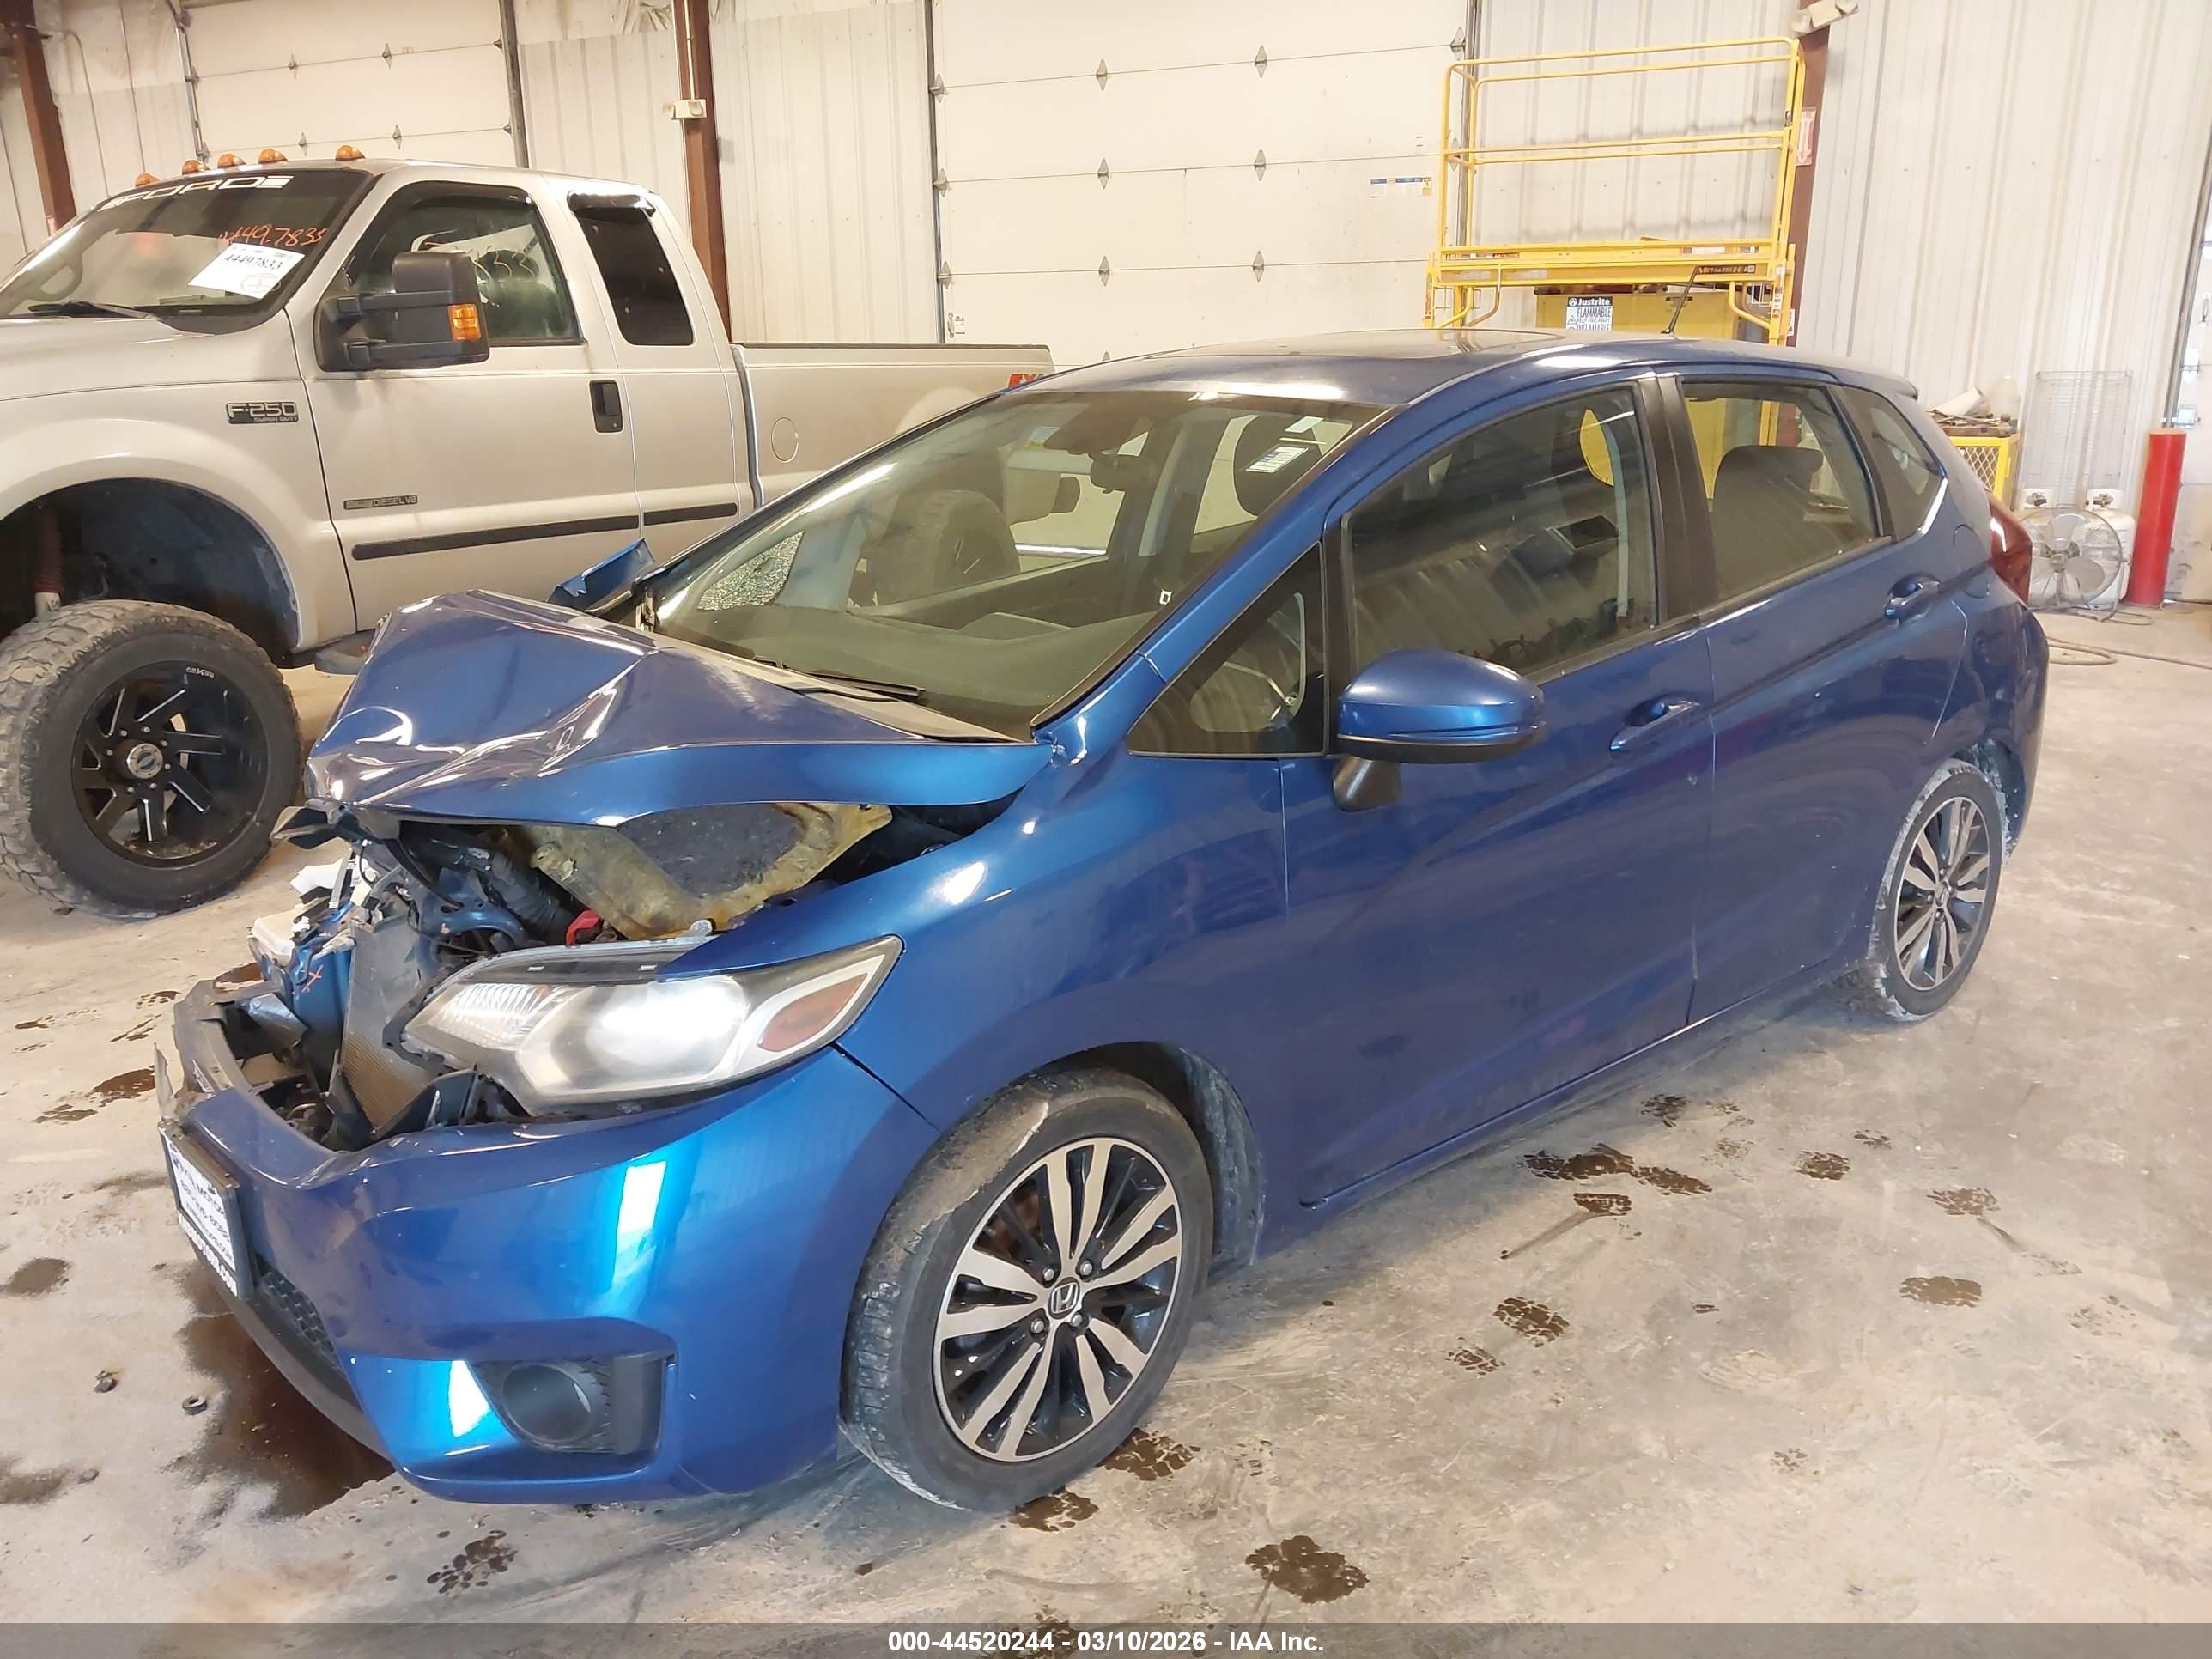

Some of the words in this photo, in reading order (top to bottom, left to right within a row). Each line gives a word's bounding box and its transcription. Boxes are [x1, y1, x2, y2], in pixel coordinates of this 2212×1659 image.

[114, 176, 267, 207] FORD
[1577, 297, 1611, 306] Justrite
[1577, 307, 1611, 318] FLAMMABLE
